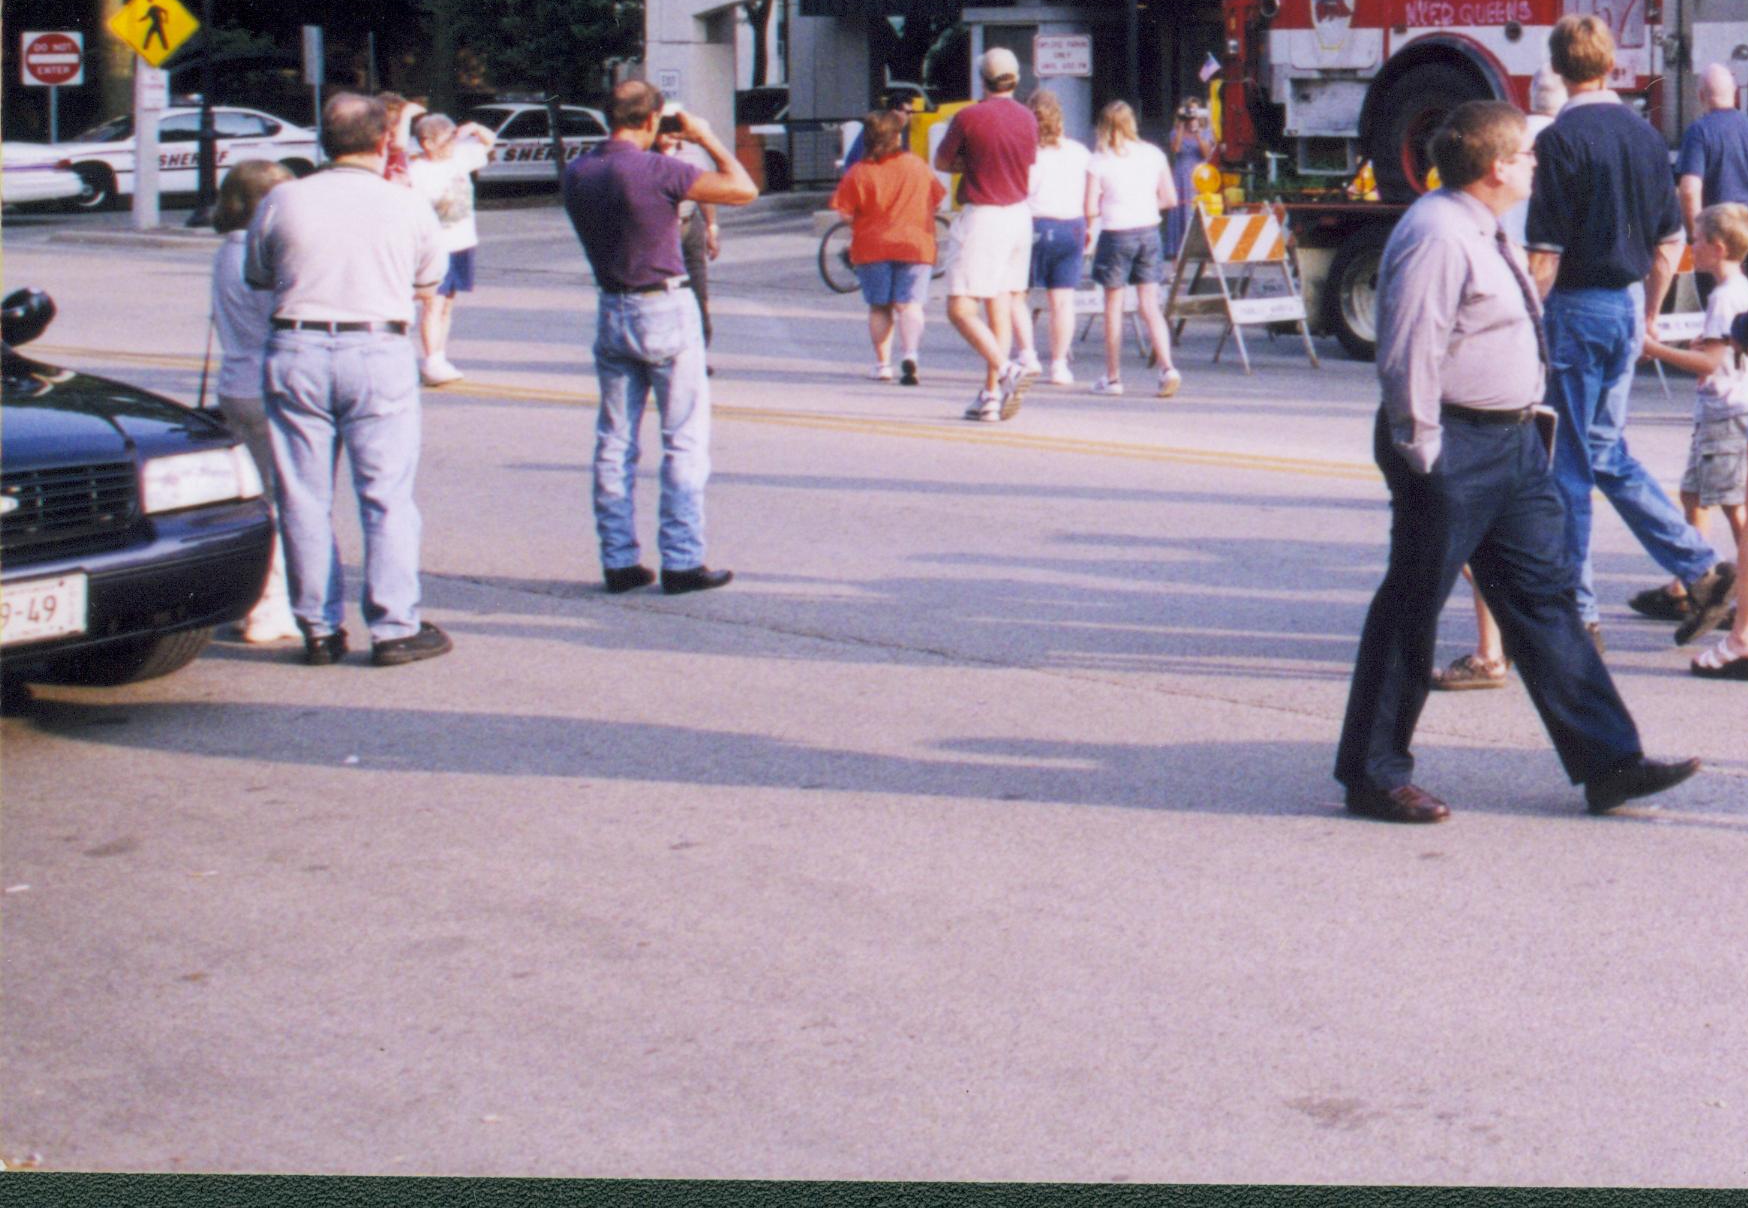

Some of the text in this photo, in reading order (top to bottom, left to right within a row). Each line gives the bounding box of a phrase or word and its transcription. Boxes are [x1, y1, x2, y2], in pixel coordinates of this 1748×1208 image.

[33, 42, 72, 53] DO NOT
[37, 65, 71, 75] ENTER
[159, 149, 230, 169] SHERF
